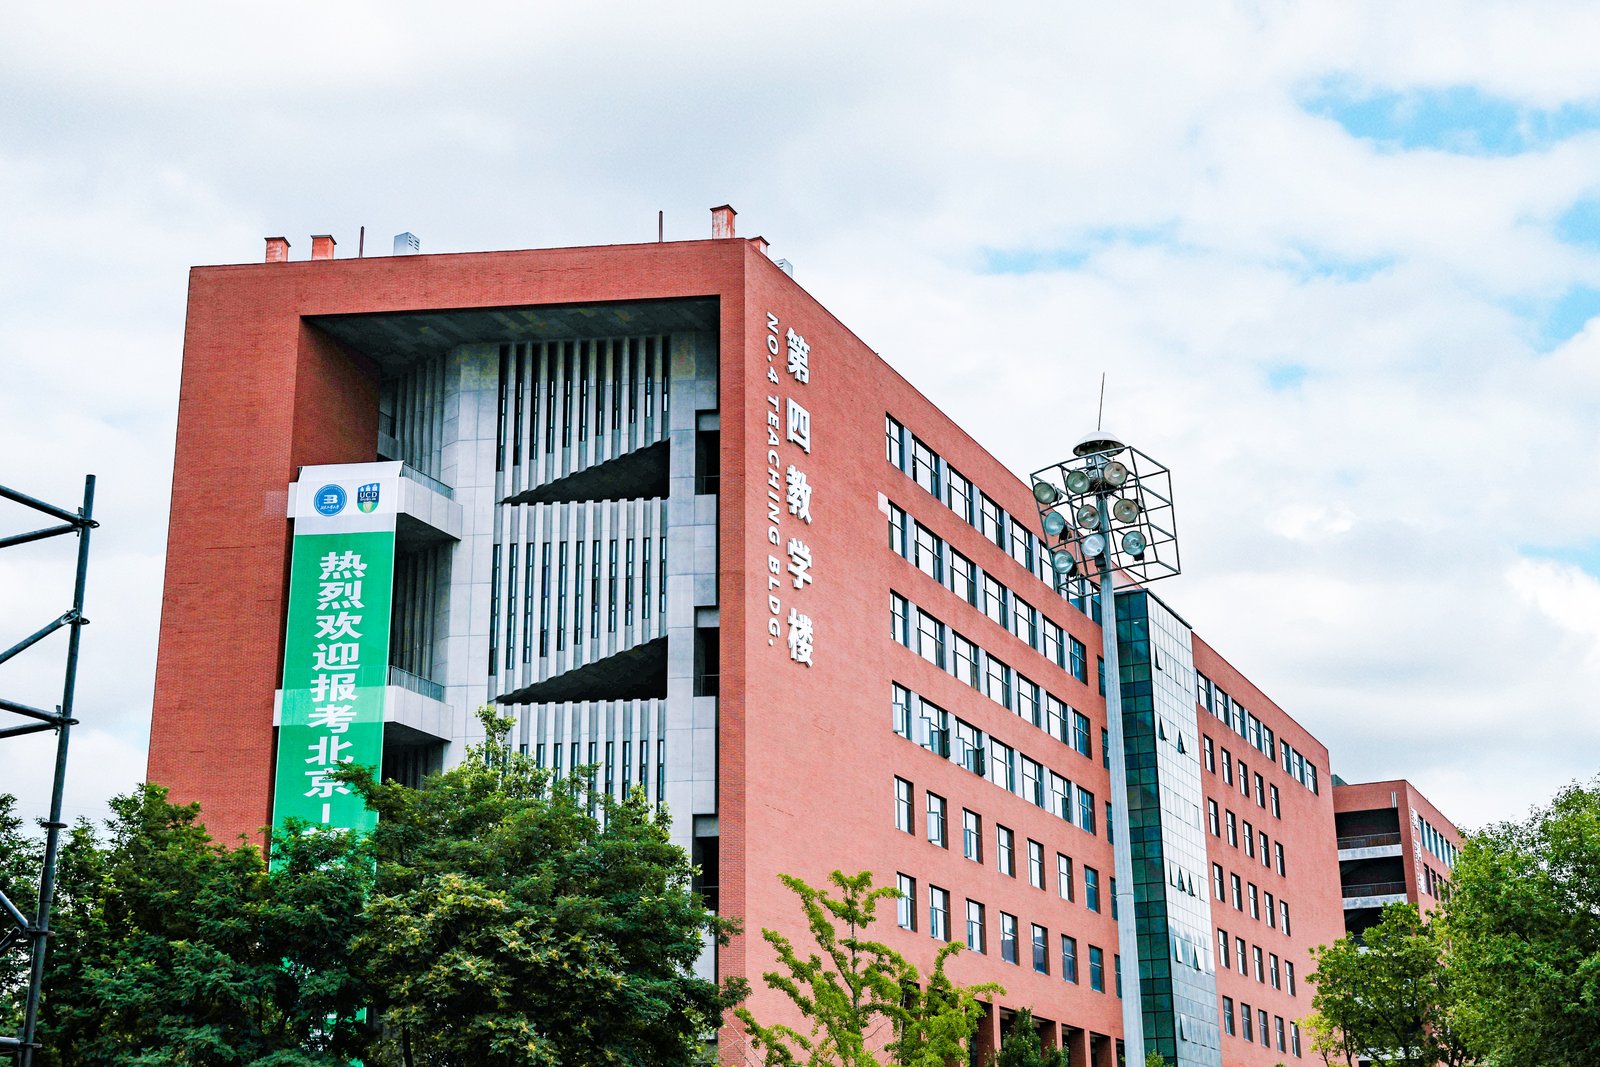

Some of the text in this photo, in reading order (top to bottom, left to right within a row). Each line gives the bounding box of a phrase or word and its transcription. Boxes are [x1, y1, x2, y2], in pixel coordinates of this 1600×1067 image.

[767, 395, 781, 546] TEACHING
[785, 326, 814, 668] 第四教学楼
[768, 554, 781, 647] BLDG.
